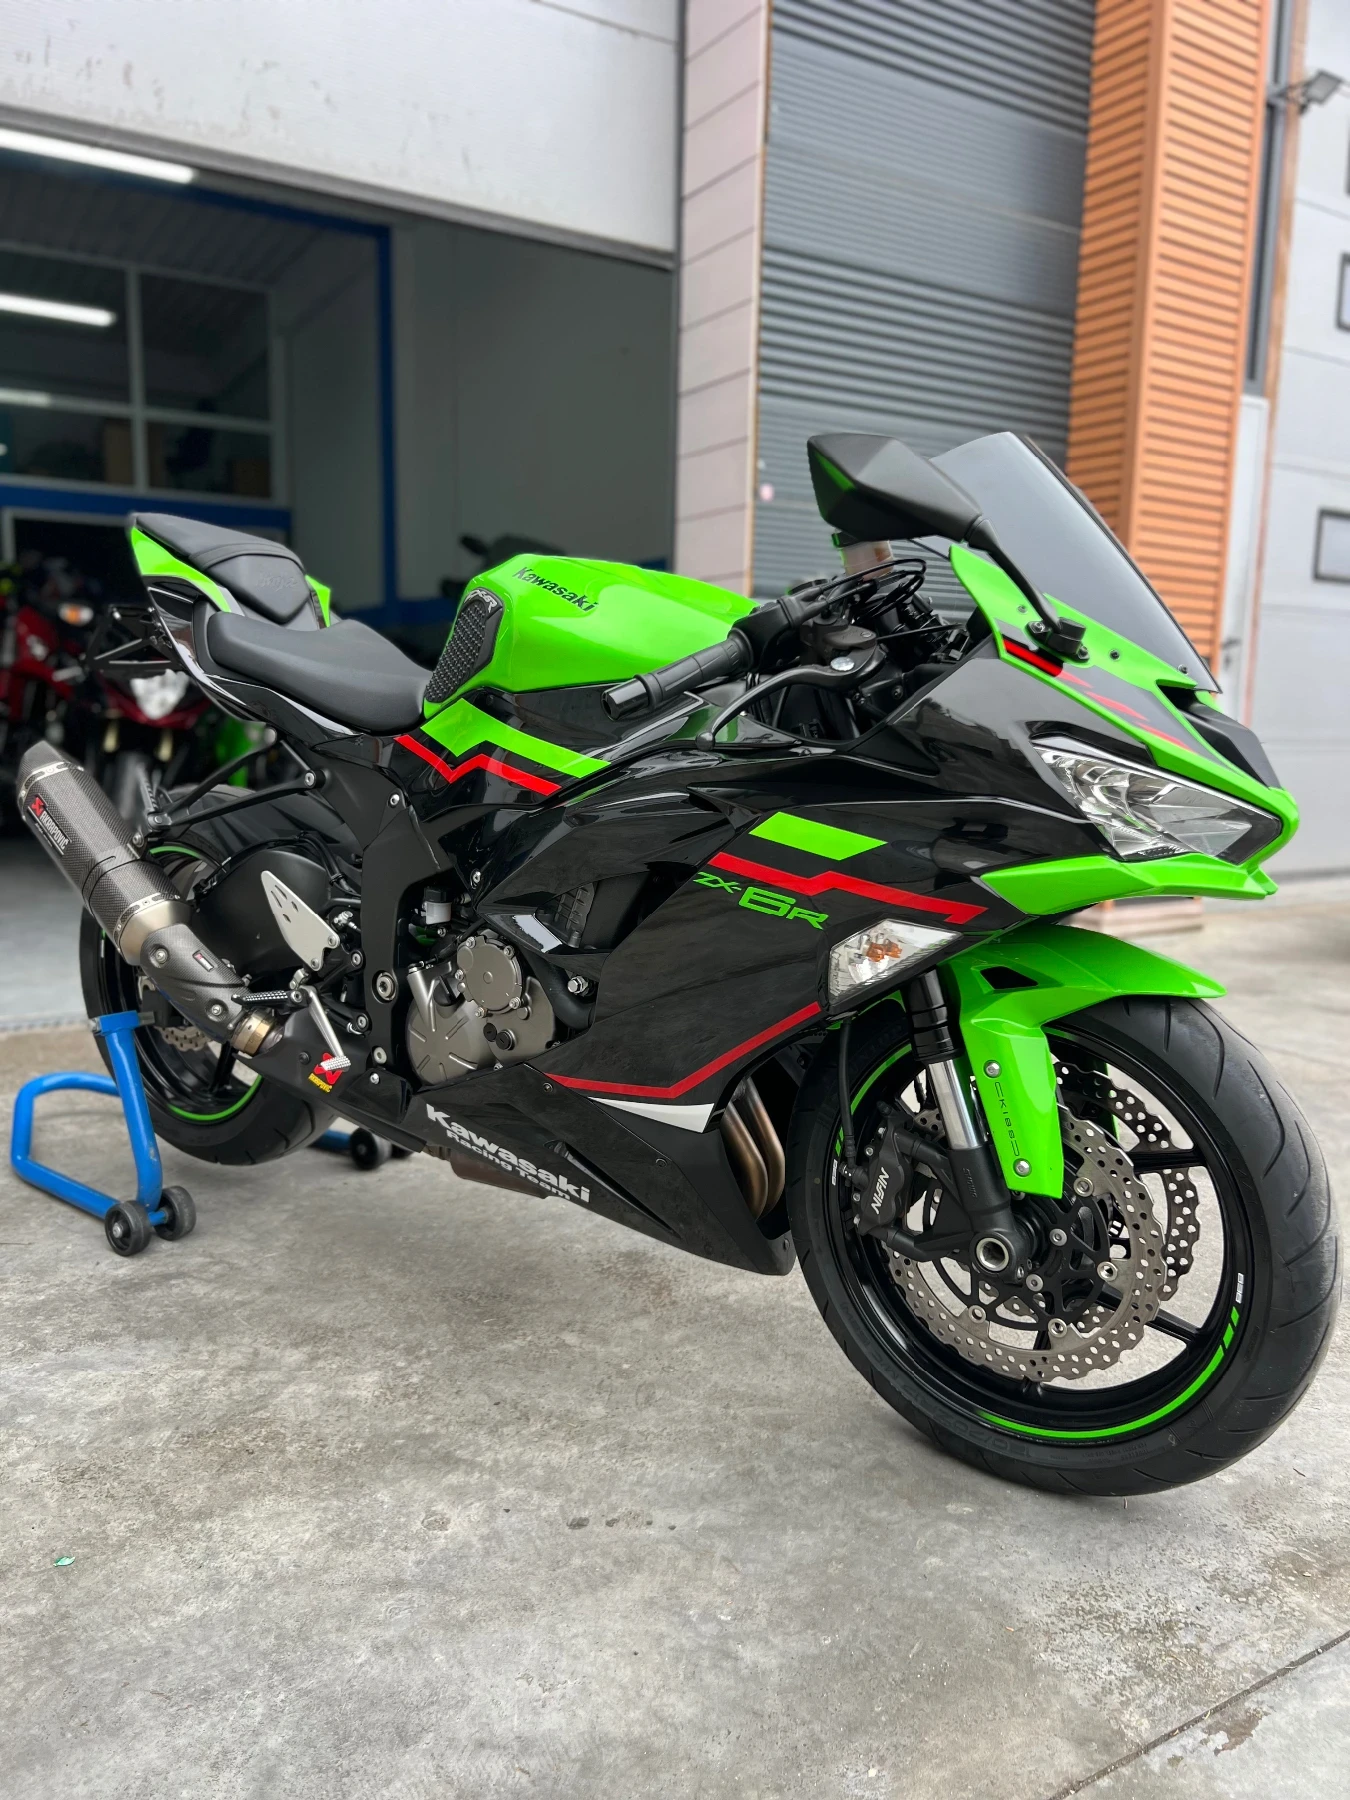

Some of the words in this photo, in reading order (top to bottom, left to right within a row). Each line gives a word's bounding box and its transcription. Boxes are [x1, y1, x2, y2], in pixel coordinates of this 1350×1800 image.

[512, 566, 598, 612] Kawasaki
[693, 871, 829, 930] ZX-6R
[426, 1103, 590, 1203] Kawasaki
[446, 1130, 513, 1171] Racing
[516, 1166, 571, 1200] Team
